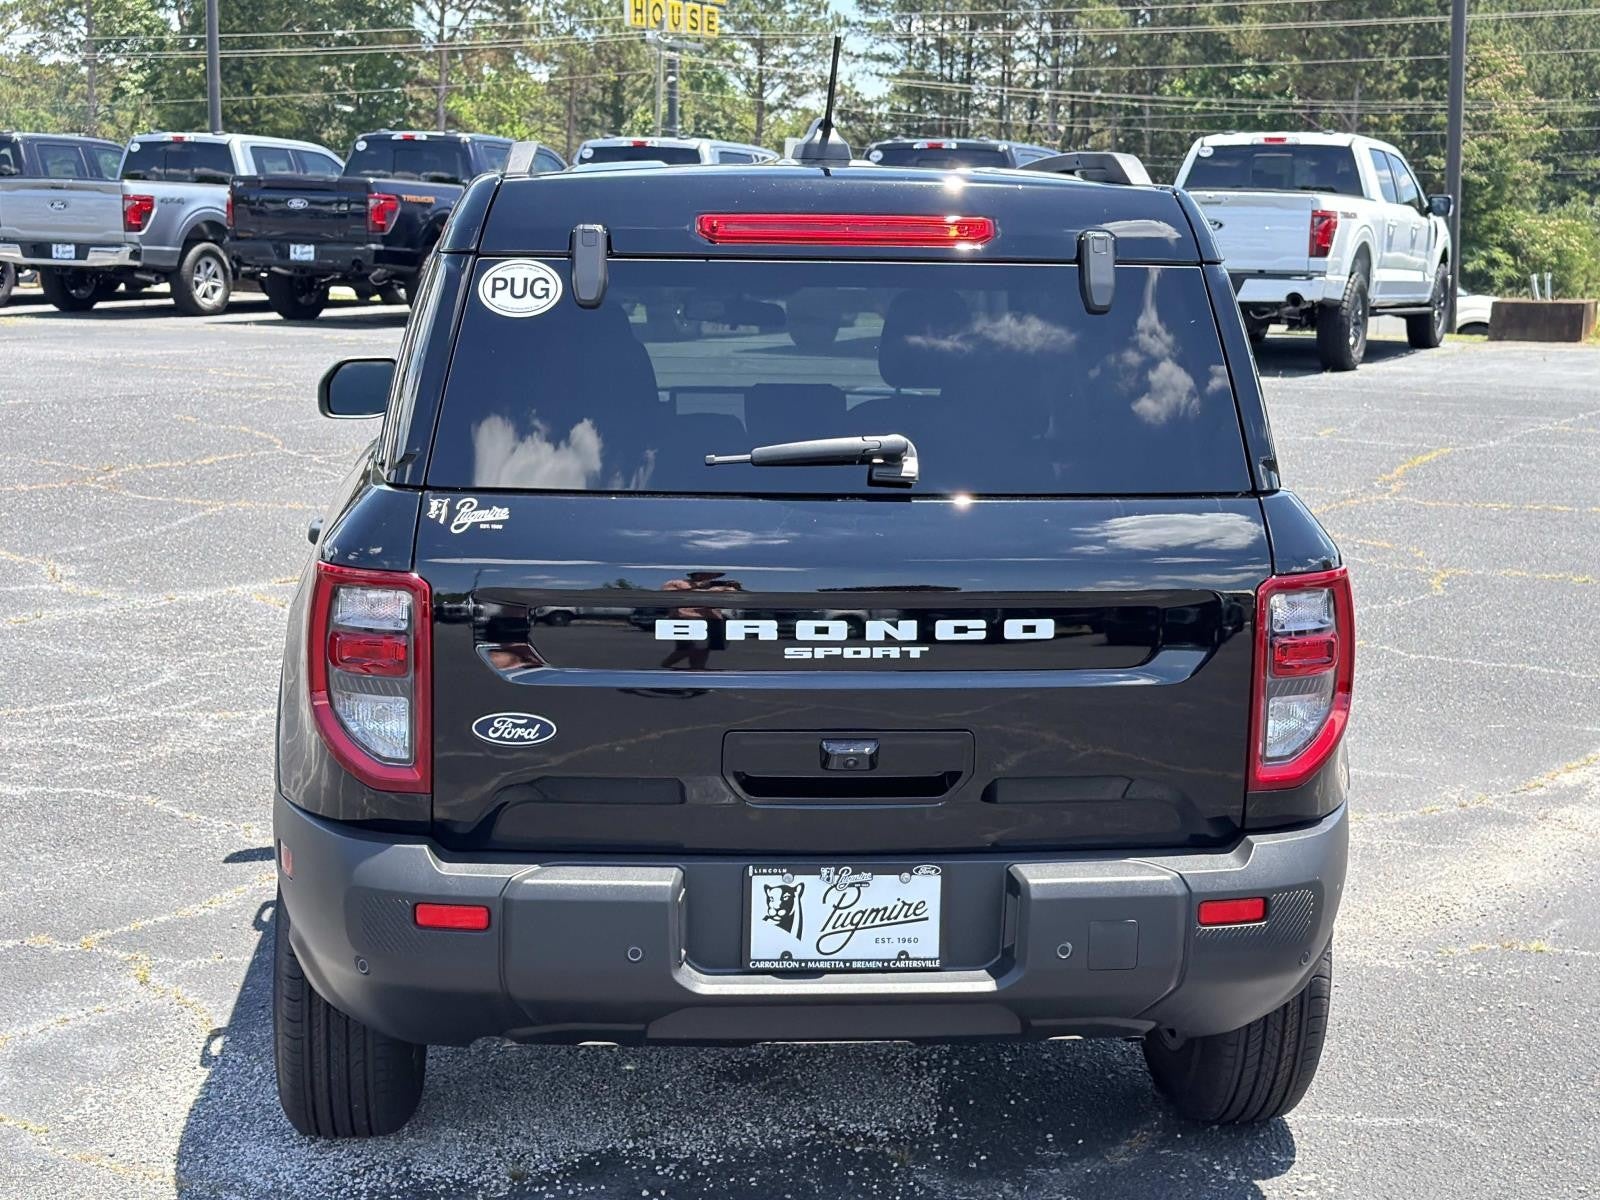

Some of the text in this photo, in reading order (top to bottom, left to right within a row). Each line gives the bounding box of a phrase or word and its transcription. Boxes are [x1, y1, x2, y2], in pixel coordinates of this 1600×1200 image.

[634, 0, 716, 32] HOUSE
[490, 276, 551, 300] PUG
[450, 497, 510, 534] Pugmire
[654, 619, 1055, 641] BRONCO
[783, 646, 929, 659] SPORT
[488, 717, 541, 739] Ford
[917, 866, 938, 876] Ford
[815, 884, 929, 956] Pugmire
[749, 959, 941, 969] CARROLLTON MARIETTA BREMEN CARTERSVILLE
